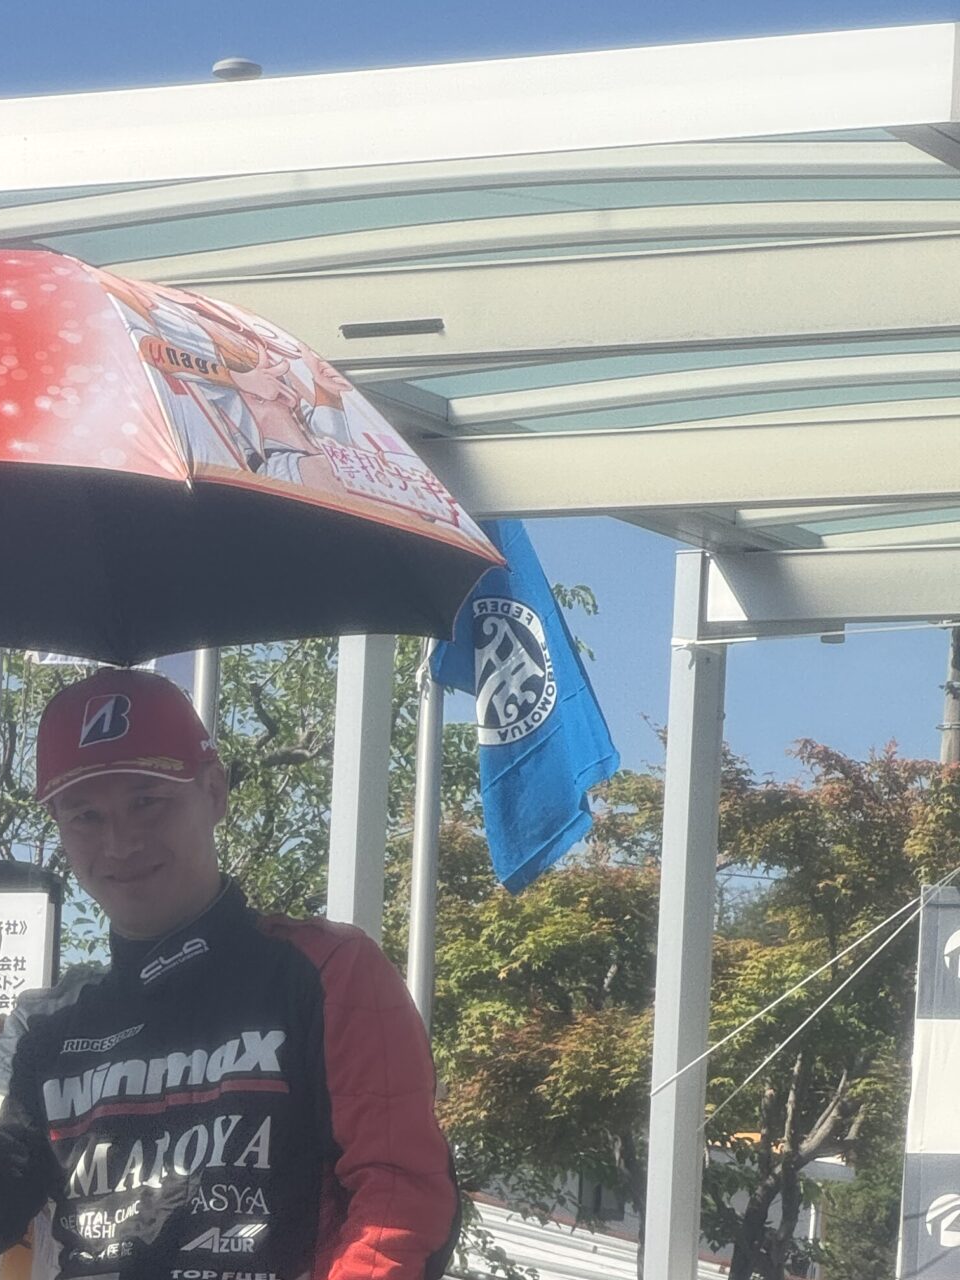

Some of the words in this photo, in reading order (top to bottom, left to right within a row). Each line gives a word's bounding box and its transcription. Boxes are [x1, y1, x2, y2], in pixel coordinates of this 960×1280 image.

[191, 1184, 271, 1215] ASYA
[180, 1226, 255, 1253] AZUR
[170, 1269, 218, 1280] TOP
